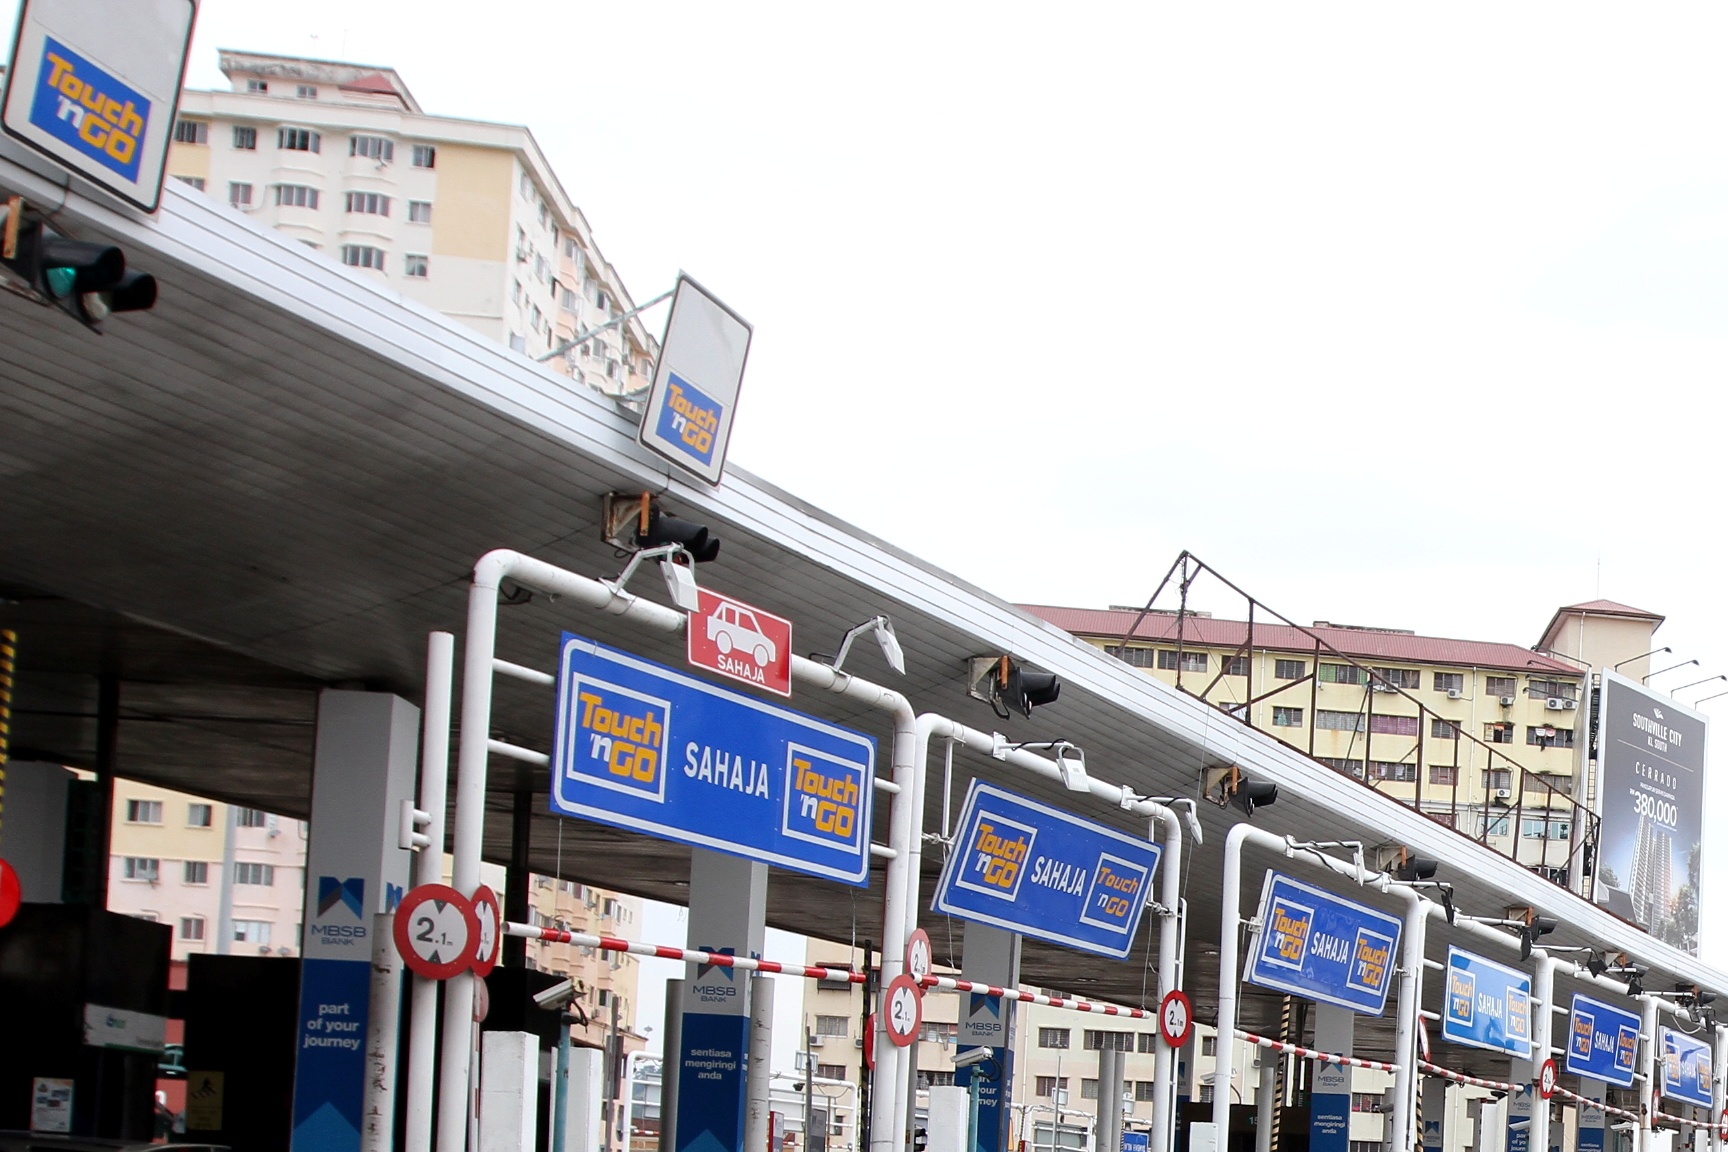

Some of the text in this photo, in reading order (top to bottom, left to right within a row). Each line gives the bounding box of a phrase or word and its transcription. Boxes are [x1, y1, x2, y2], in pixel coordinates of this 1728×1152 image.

[46, 52, 144, 138] Touch
[79, 112, 137, 165] GO
[668, 383, 718, 434] Touch
[681, 421, 713, 454] GO
[717, 654, 766, 685] SAHAJA
[579, 691, 663, 747] Touch
[1632, 712, 1683, 747] SOUTHVILLE CITY
[608, 740, 658, 784] GO
[683, 741, 770, 800] SAHAJA
[1635, 761, 1677, 790] CERRADO
[793, 758, 859, 806] Touch
[815, 800, 855, 838] GO
[975, 823, 1029, 864] Touch
[983, 857, 1020, 889] GO
[1030, 855, 1087, 898] SAHAJA
[1097, 867, 1139, 895] Touch
[1105, 896, 1130, 917] GO
[311, 924, 367, 938] MBSB
[1273, 907, 1309, 939] Touch
[321, 937, 354, 946] BANK
[1280, 936, 1303, 960] GO
[1310, 931, 1350, 965] SAHAJA
[1356, 938, 1389, 967] Touch
[1362, 964, 1383, 987] GO
[1451, 975, 1473, 998] Touch
[692, 985, 737, 997] MBSB
[1477, 992, 1503, 1019] SAHAJA
[1508, 994, 1528, 1016] Touch
[318, 1003, 350, 1016] part
[307, 1018, 360, 1033] of your
[965, 1021, 1002, 1032] MBSB
[303, 1033, 361, 1050] journey
[690, 1048, 732, 1058] sentiasa
[685, 1059, 737, 1071] mengiringi
[697, 1071, 723, 1080] anda
